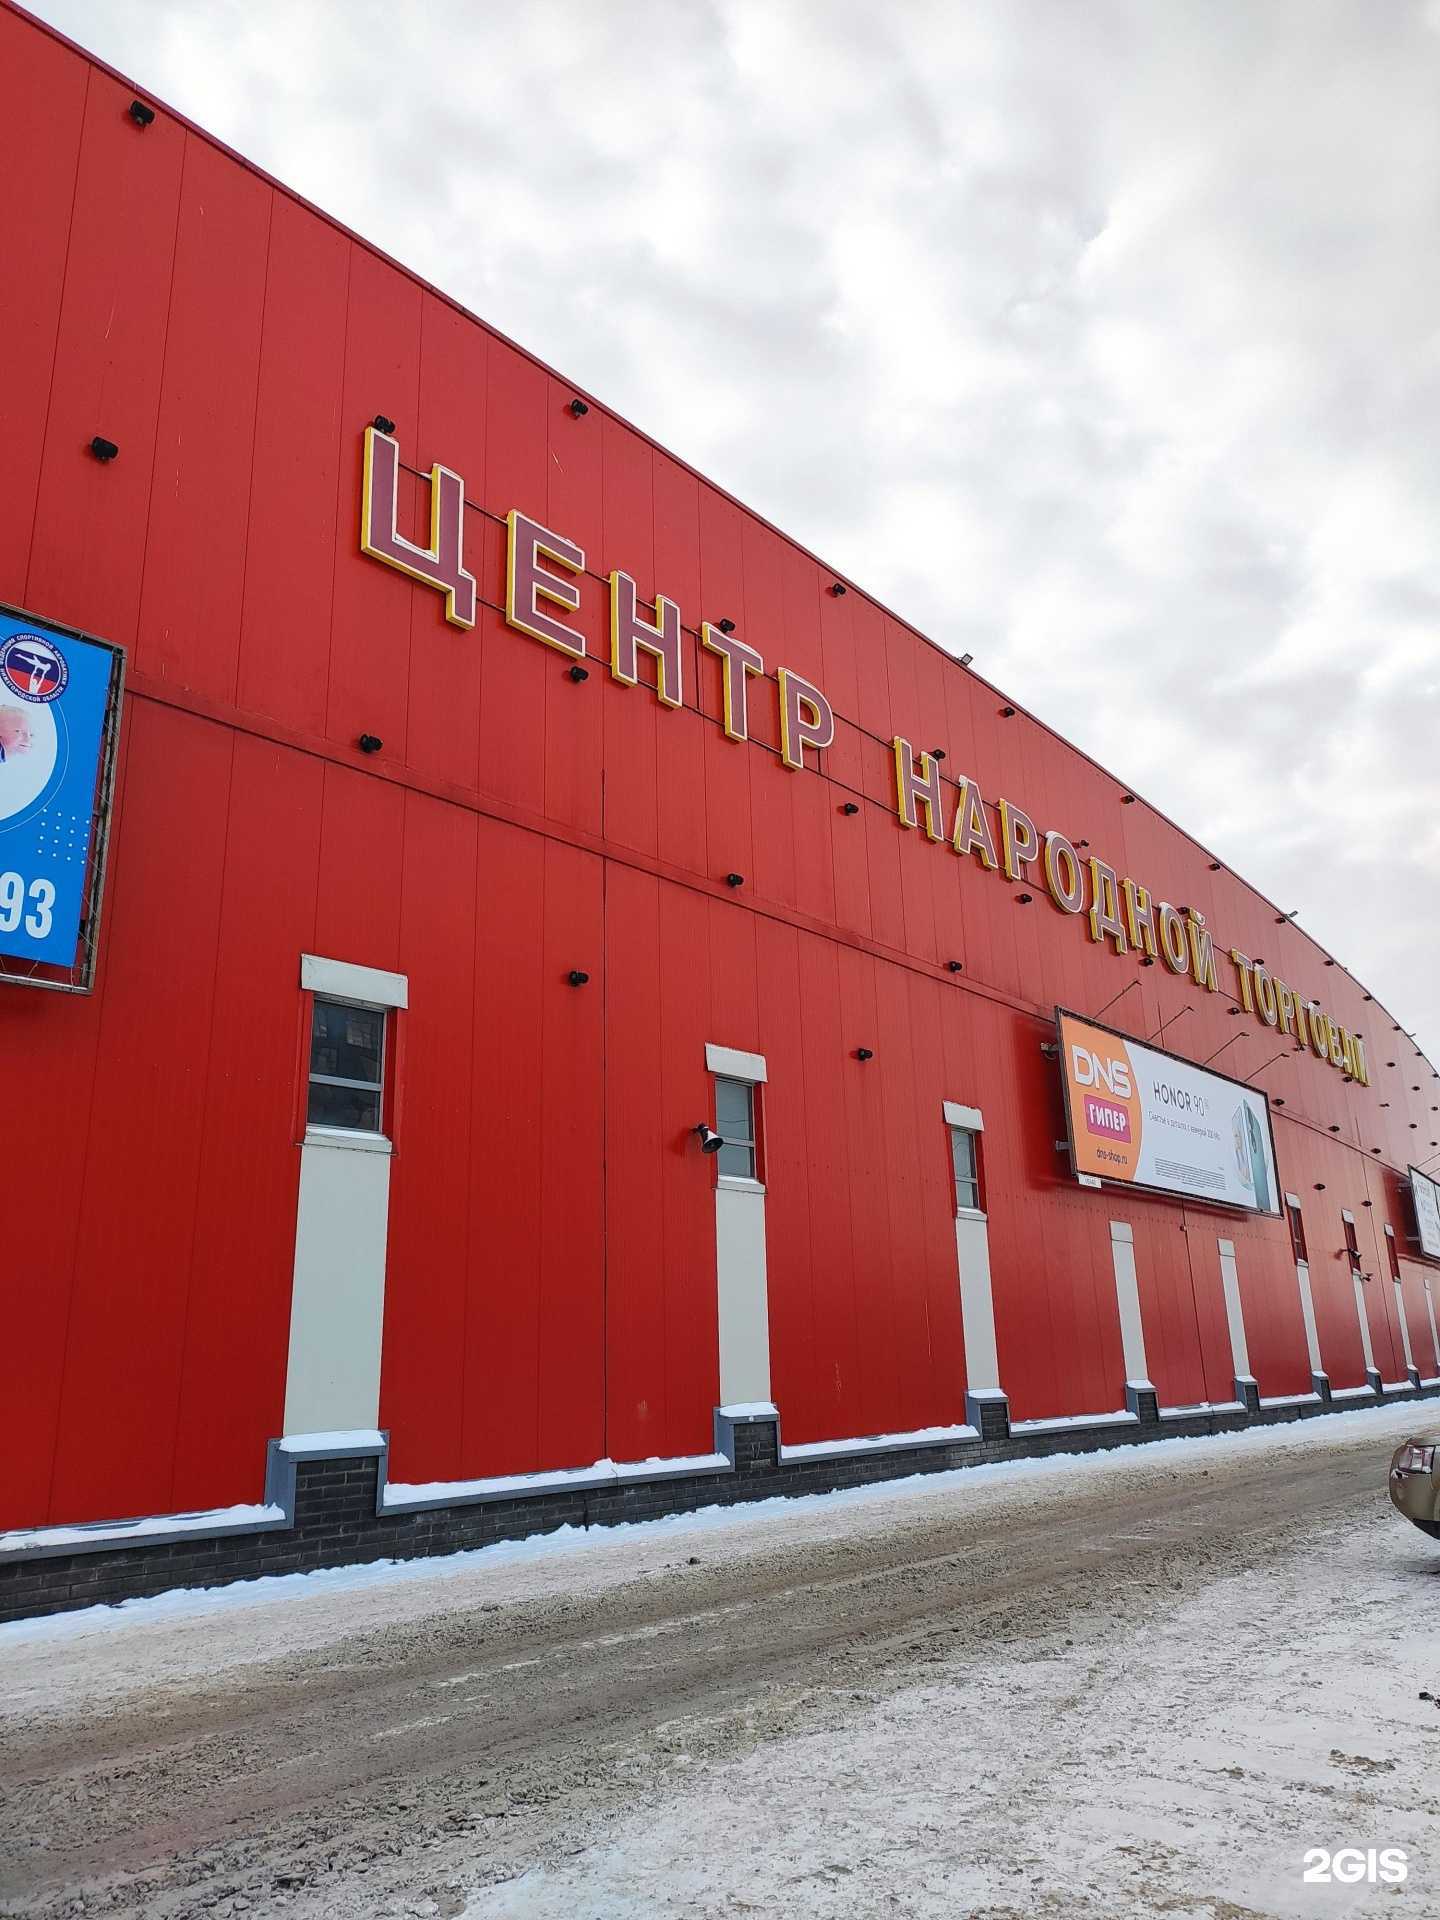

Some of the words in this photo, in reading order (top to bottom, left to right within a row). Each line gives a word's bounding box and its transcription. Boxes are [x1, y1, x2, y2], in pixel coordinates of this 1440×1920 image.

[361, 426, 835, 771] ЦЕНТР
[894, 736, 1218, 992] НАРОДНОЙ
[0, 871, 56, 939] 93
[1072, 1044, 1132, 1099] DNS
[1089, 1103, 1127, 1133] ГИПЕР
[1153, 1079, 1192, 1113] HONOR
[1193, 1095, 1205, 1117] 90
[1096, 1146, 1128, 1166] dns-shop.ru
